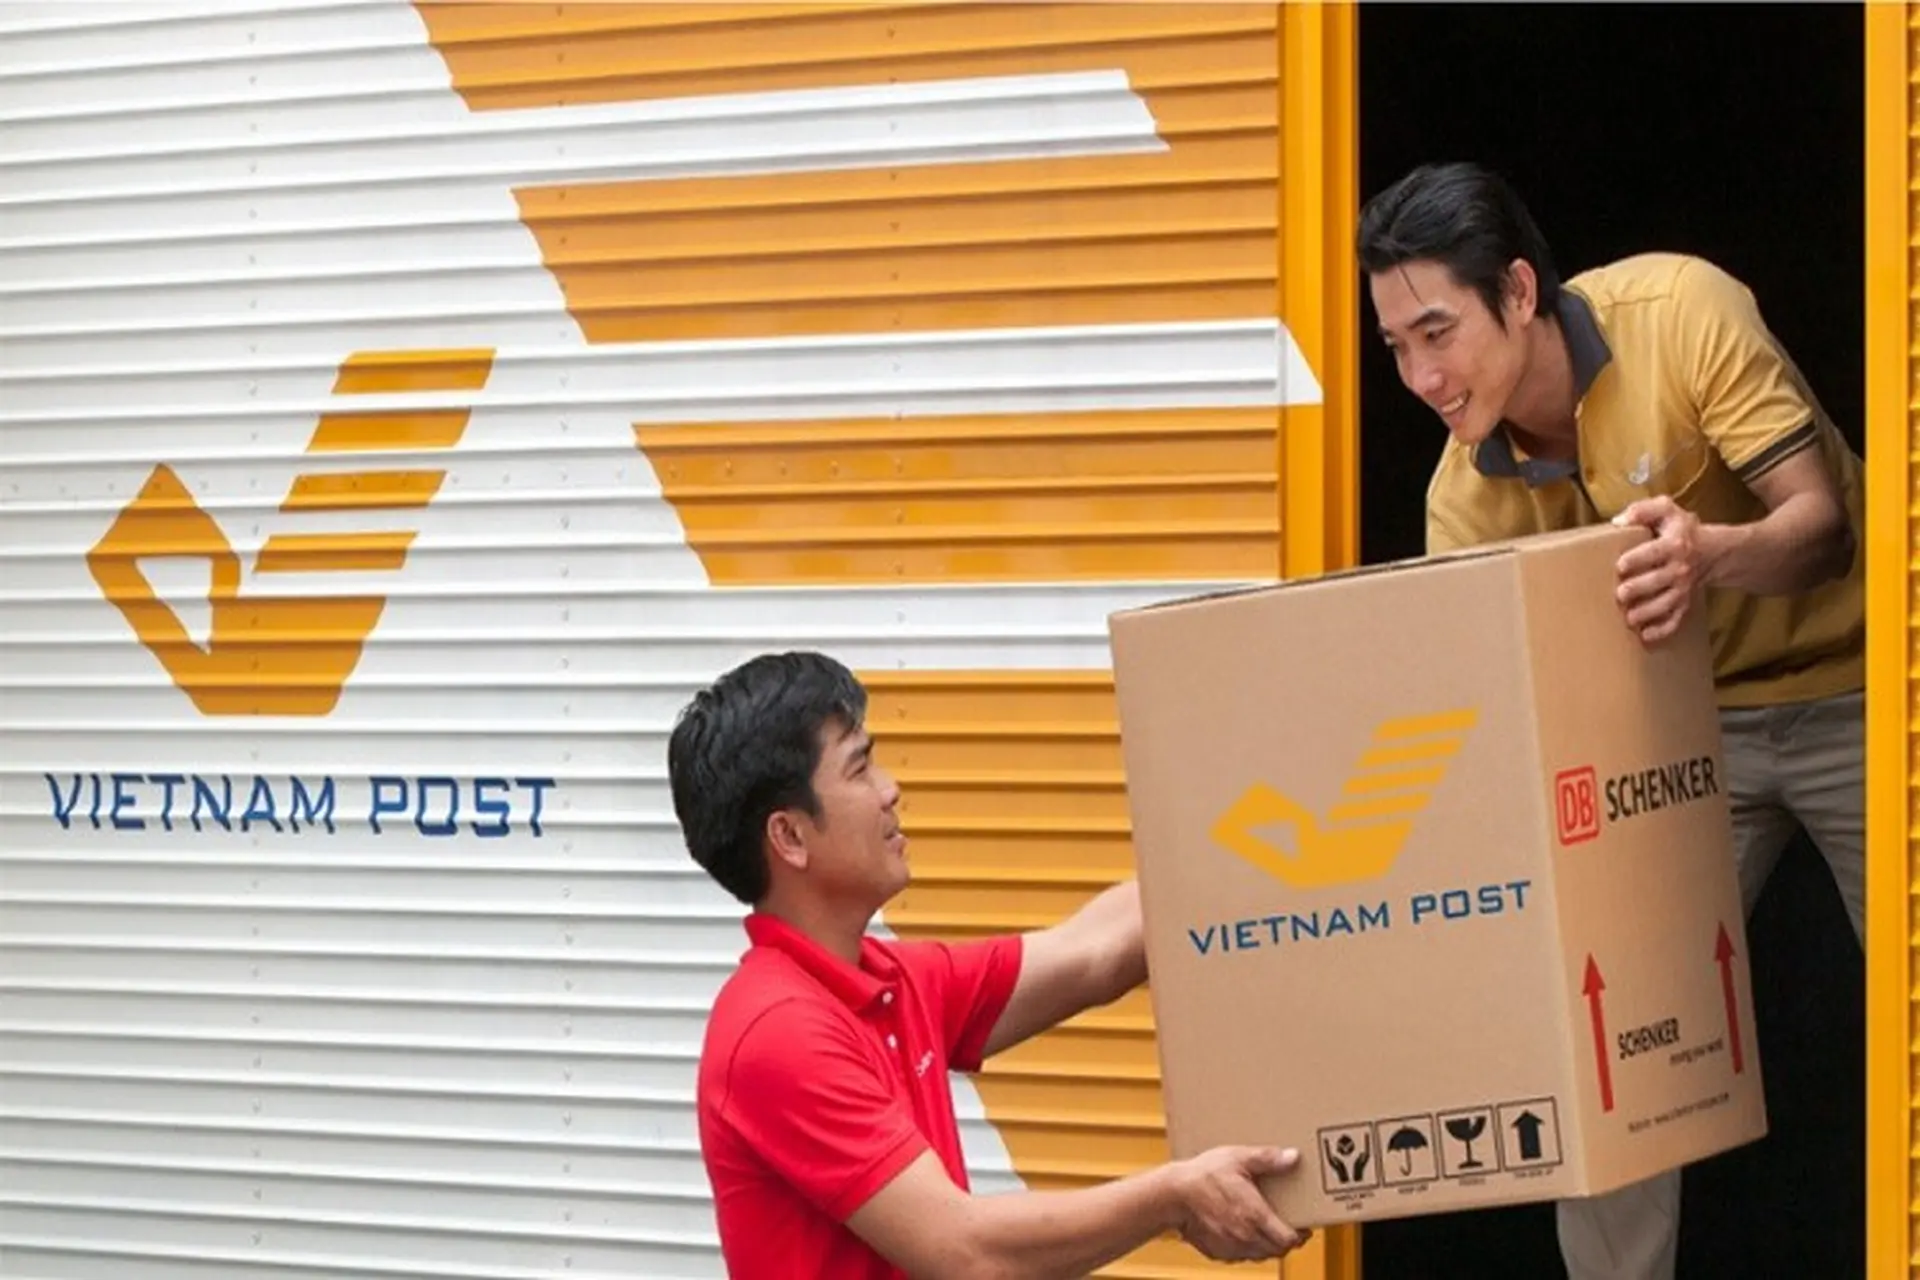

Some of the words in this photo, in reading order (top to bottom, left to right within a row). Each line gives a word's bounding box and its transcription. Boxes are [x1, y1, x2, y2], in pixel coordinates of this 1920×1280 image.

[44, 771, 336, 835] VIETNAM
[369, 775, 557, 838] POST
[1560, 778, 1595, 832] DB
[1604, 755, 1719, 823] SCHENKER
[1188, 901, 1391, 955] VIETNAM
[1410, 880, 1533, 925] POST
